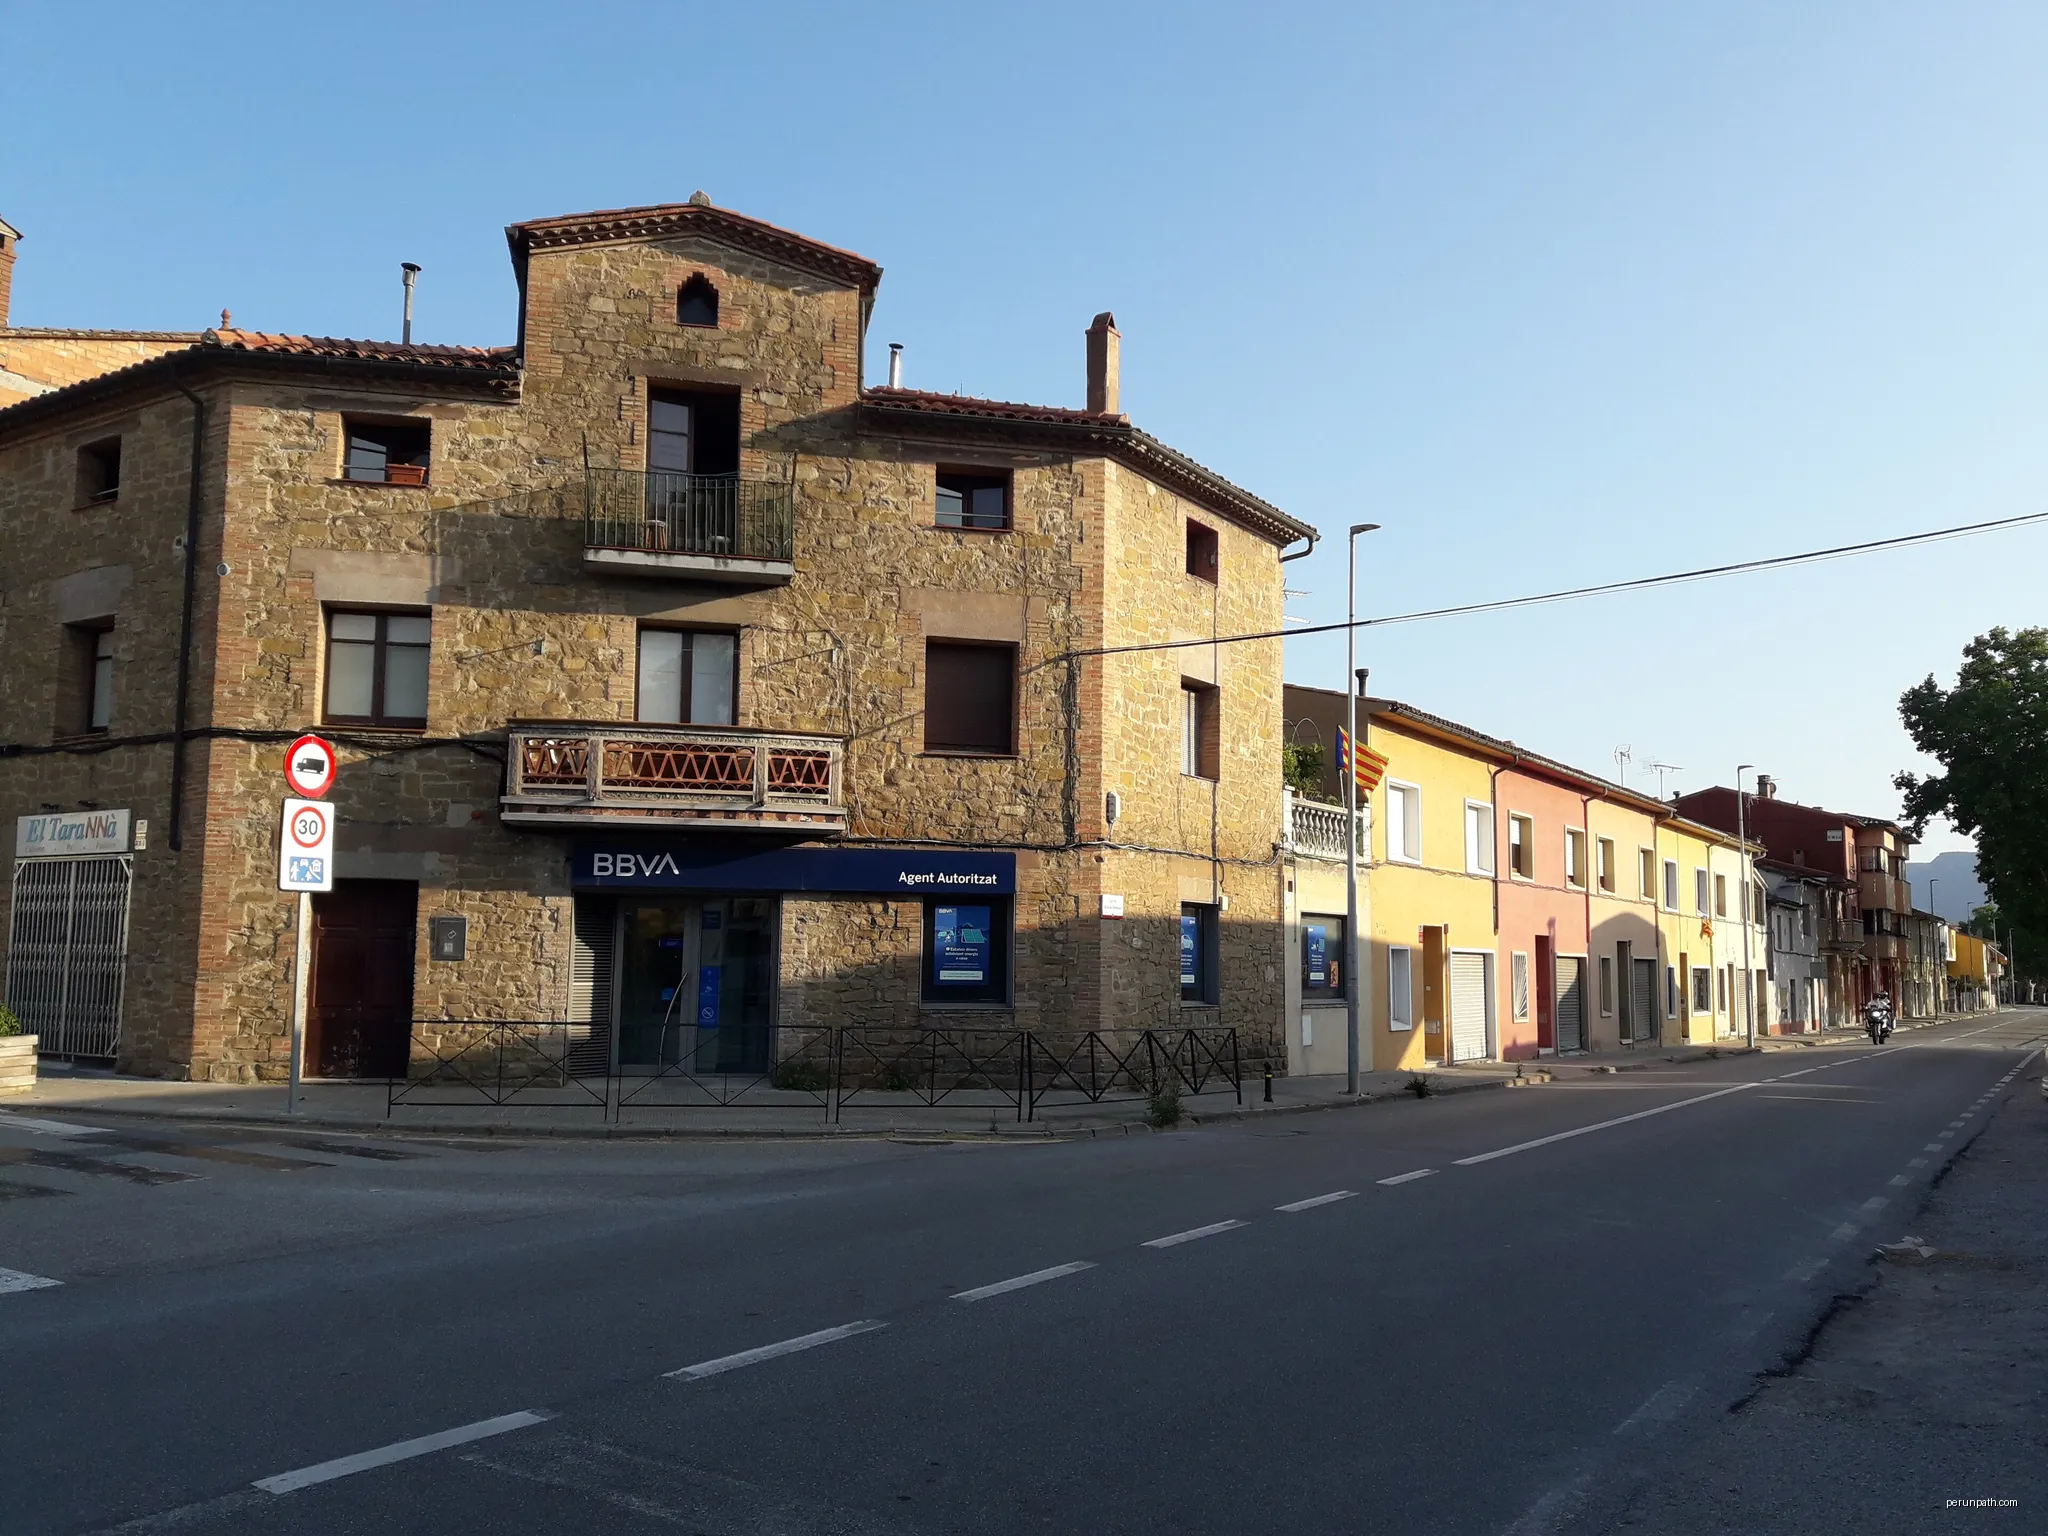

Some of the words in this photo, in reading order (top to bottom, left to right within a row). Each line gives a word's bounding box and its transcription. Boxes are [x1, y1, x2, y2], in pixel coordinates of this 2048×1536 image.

[26, 818, 46, 842] El
[298, 819, 318, 836] 30
[593, 852, 680, 877] BBVA
[898, 871, 935, 886] Agent
[937, 872, 998, 885] Autoritzat
